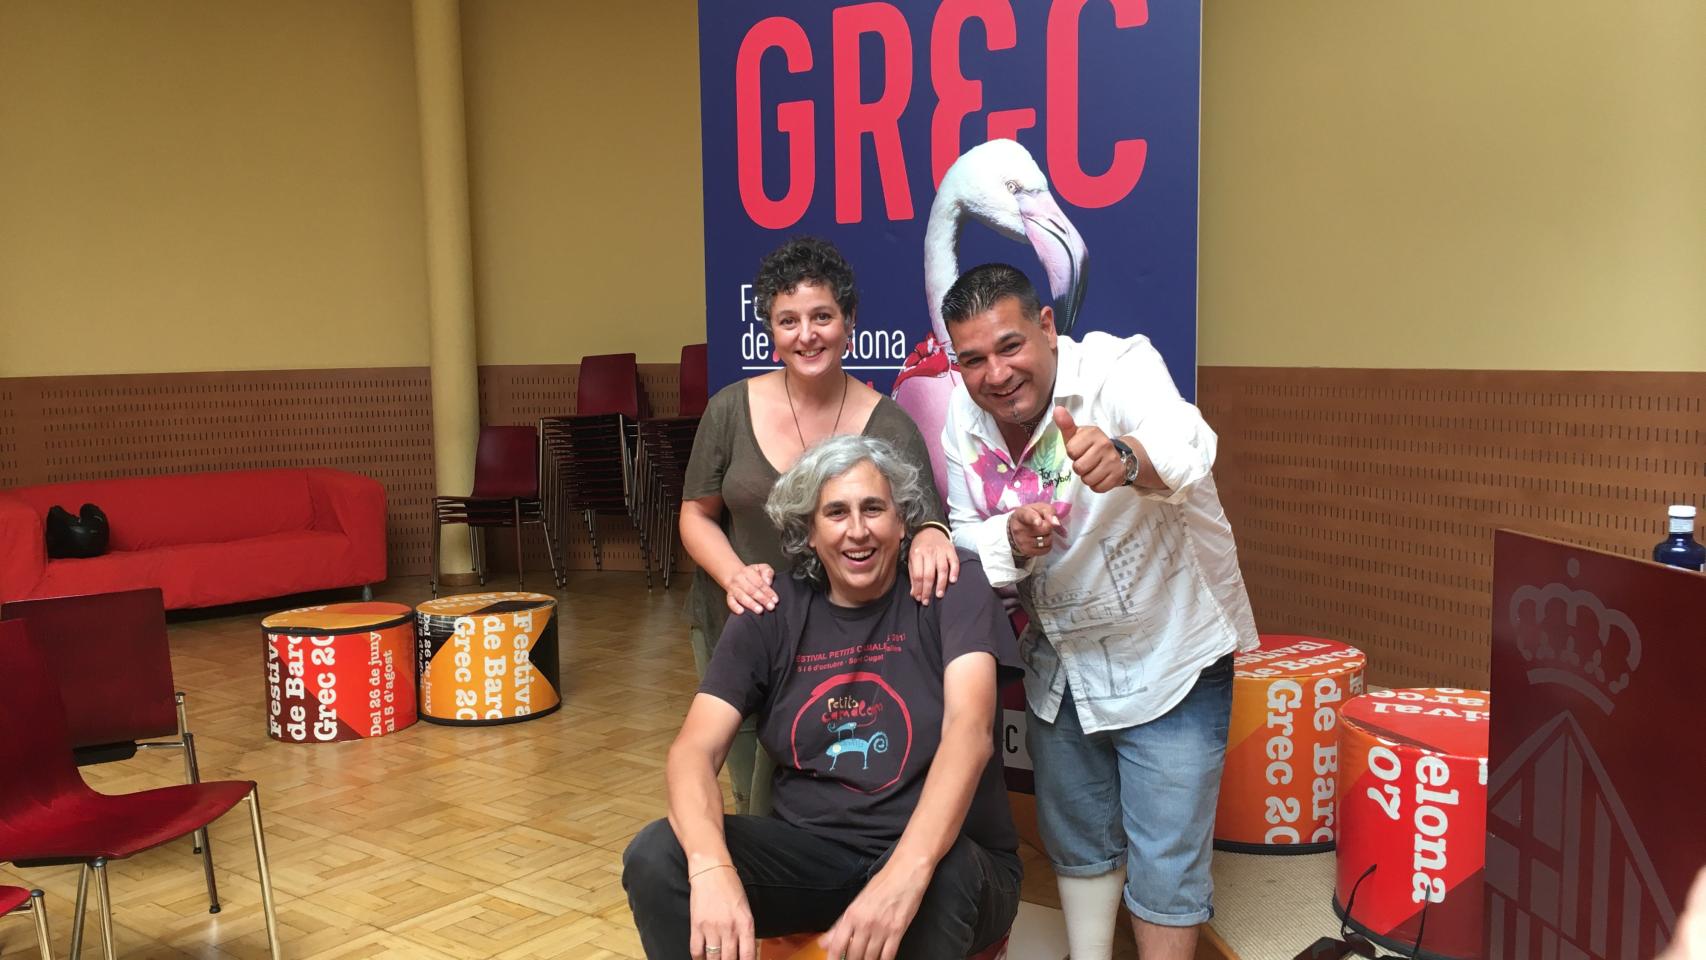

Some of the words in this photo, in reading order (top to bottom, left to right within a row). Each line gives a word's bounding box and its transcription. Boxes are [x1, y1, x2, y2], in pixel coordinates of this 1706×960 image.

[741, 323, 769, 360] de
[368, 632, 382, 666] juny
[454, 617, 476, 683] Grec
[483, 615, 505, 650] de
[369, 668, 381, 686] de
[314, 672, 337, 741] Grec
[369, 689, 381, 708] 26
[1313, 678, 1342, 732] de
[287, 706, 306, 741] de
[370, 711, 382, 736] Del
[386, 718, 395, 733] al
[1265, 679, 1303, 785] Grec
[1367, 746, 1402, 820] 07
